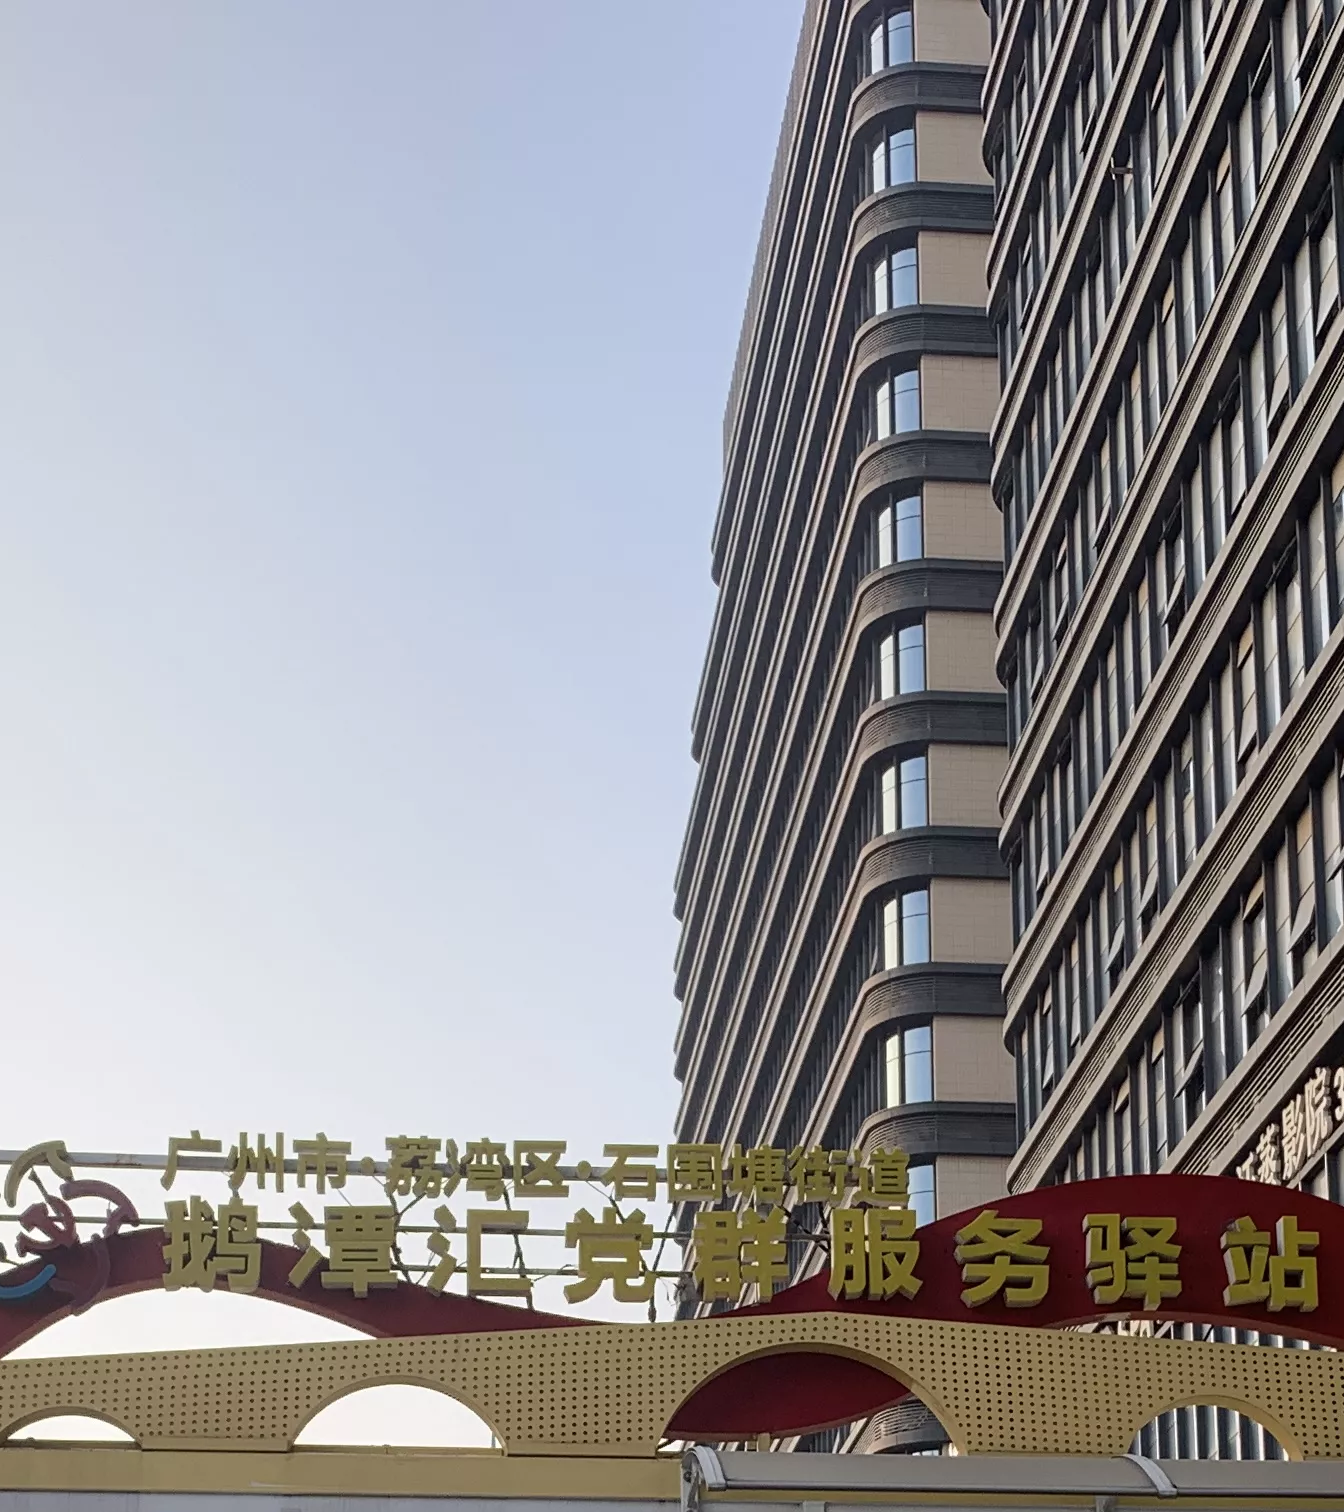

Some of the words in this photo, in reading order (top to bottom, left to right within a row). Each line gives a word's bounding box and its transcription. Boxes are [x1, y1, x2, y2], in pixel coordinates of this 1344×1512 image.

[161, 1130, 911, 1210] 广州市·荔湾区·石围塘街道
[161, 1196, 1321, 1310] 鹅潭汇党群服务驿站
